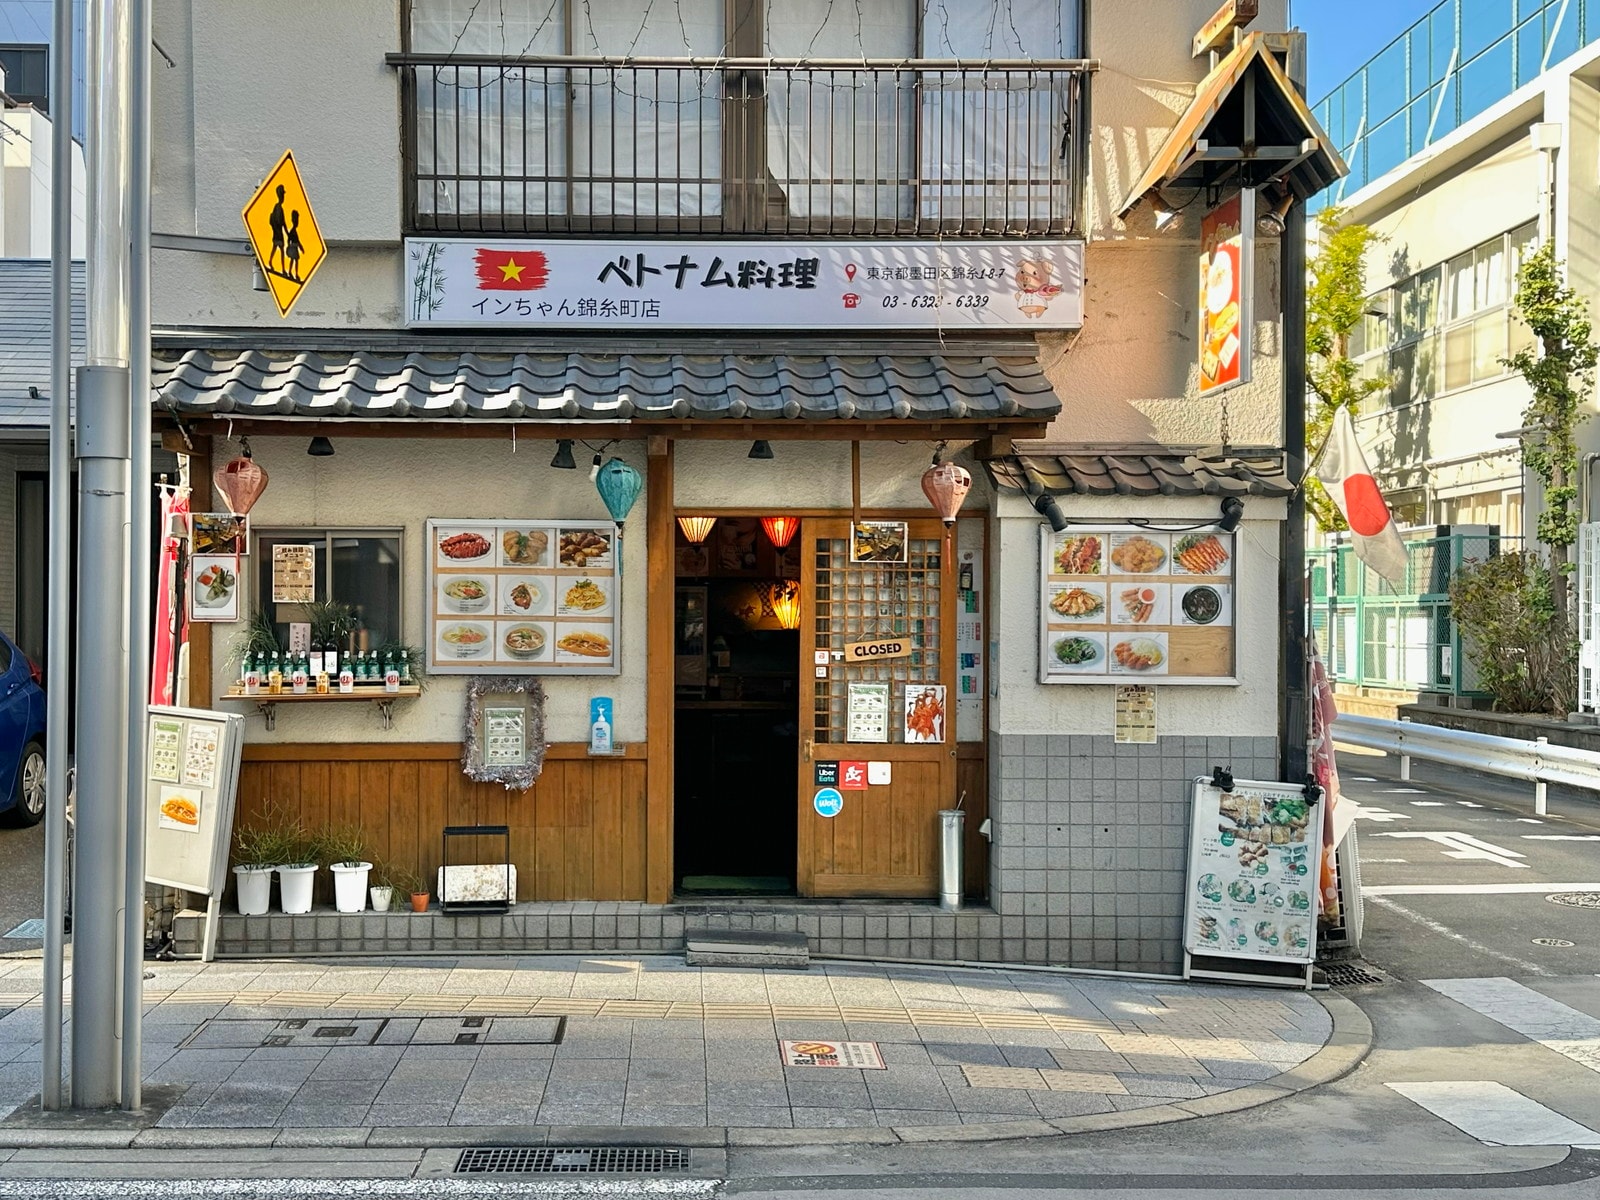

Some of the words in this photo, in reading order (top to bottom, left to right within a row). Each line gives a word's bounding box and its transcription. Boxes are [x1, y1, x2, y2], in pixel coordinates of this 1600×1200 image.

[597, 253, 819, 290] ベトナム料理
[472, 297, 661, 318] インちゃん錦糸町店
[854, 643, 902, 657] CLOSED
[818, 769, 836, 777] Uber
